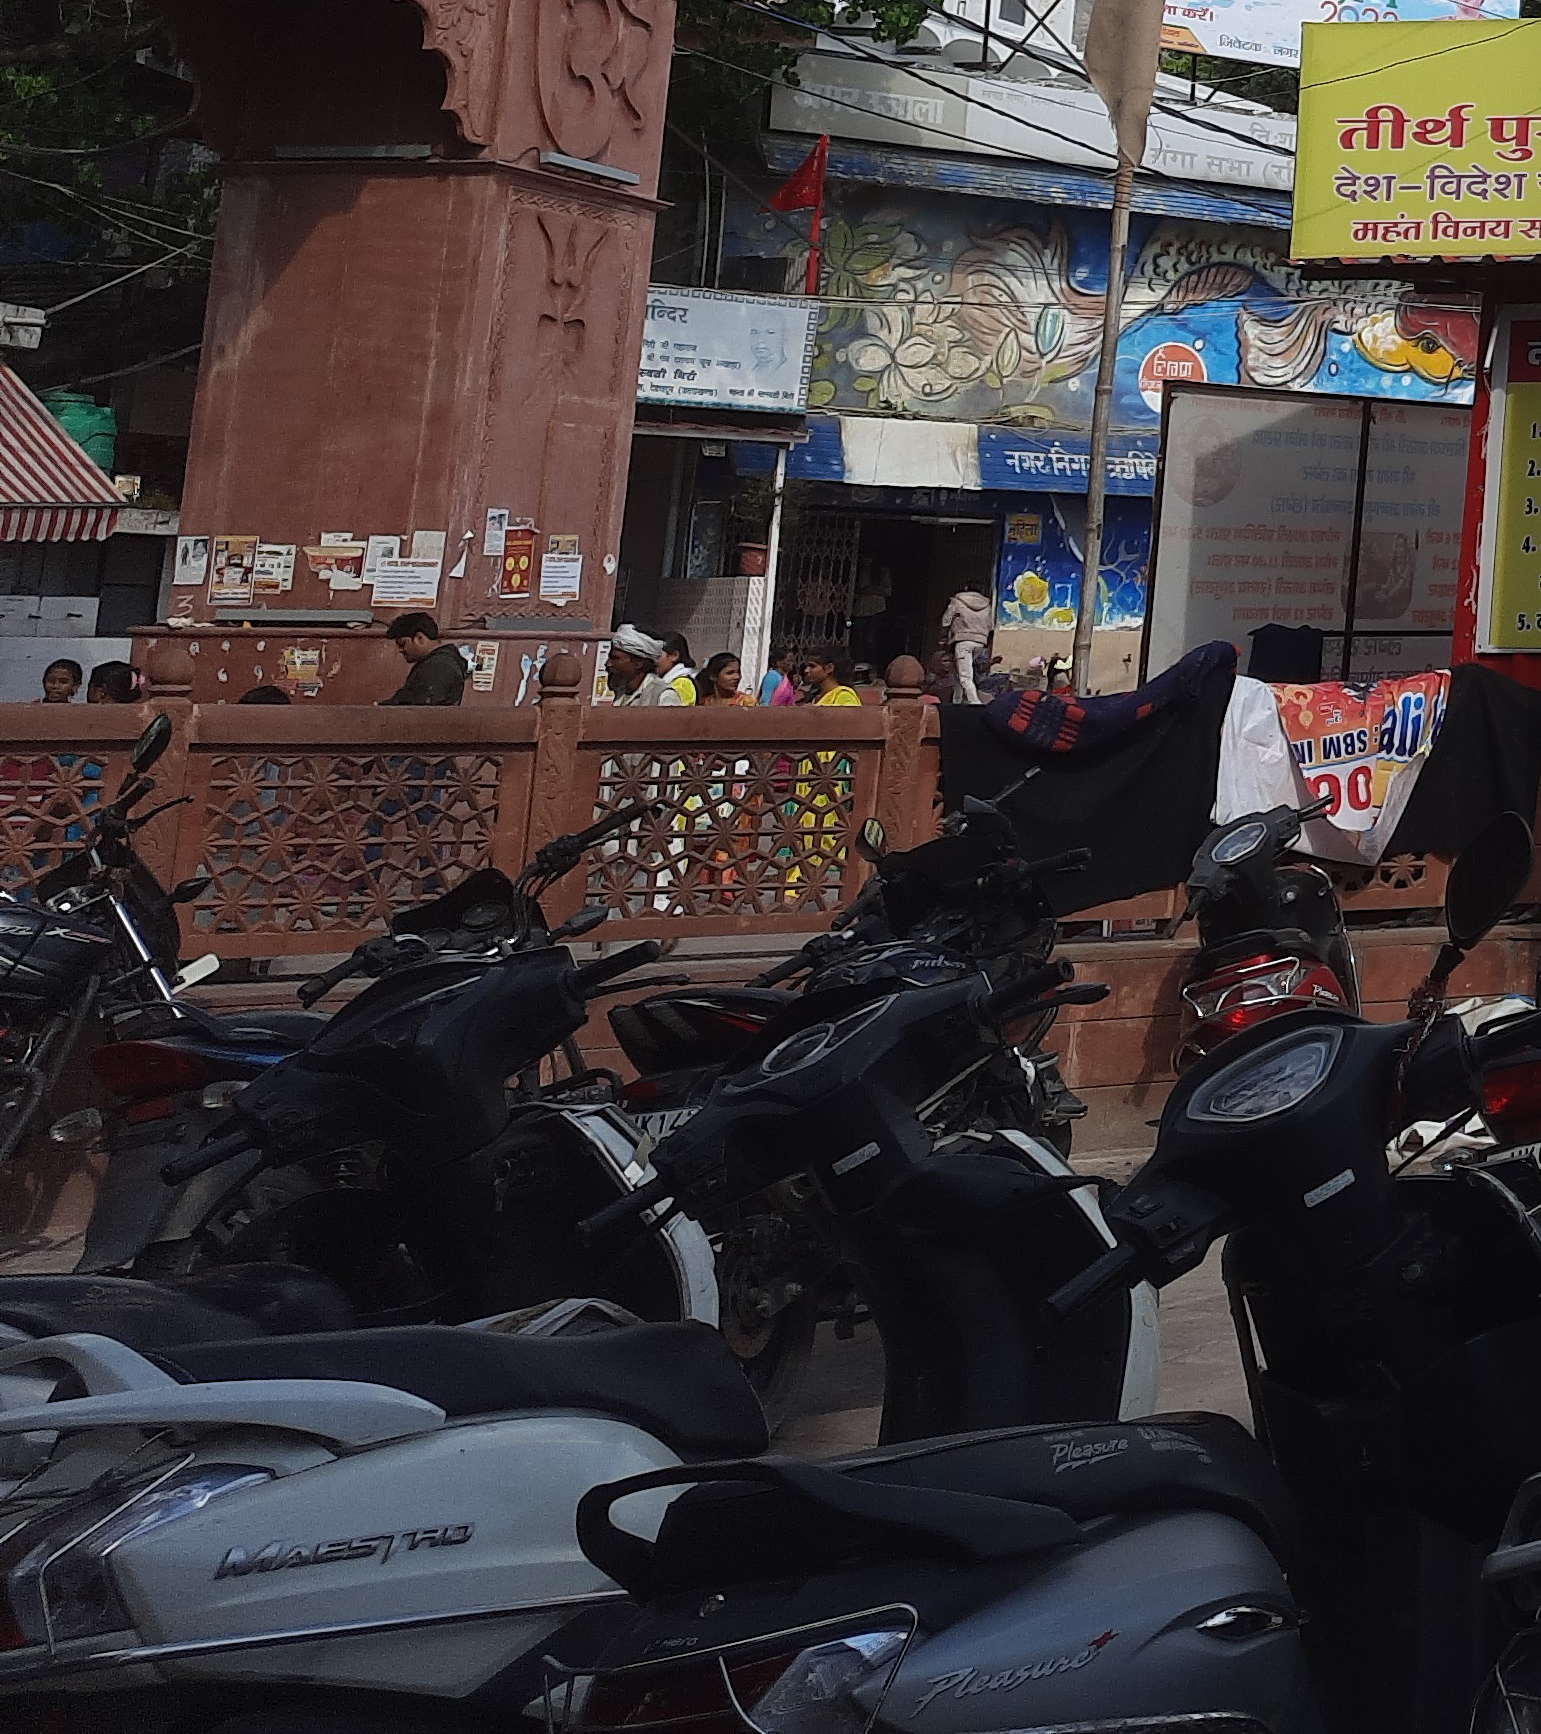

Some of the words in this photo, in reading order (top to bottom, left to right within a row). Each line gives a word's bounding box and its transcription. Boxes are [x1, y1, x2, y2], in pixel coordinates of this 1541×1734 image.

[1336, 103, 1473, 151] तीर्थ
[1334, 163, 1527, 203] देश-विदेश
[1431, 213, 1513, 241] विनय
[212, 1520, 477, 1581] MAESTRO
